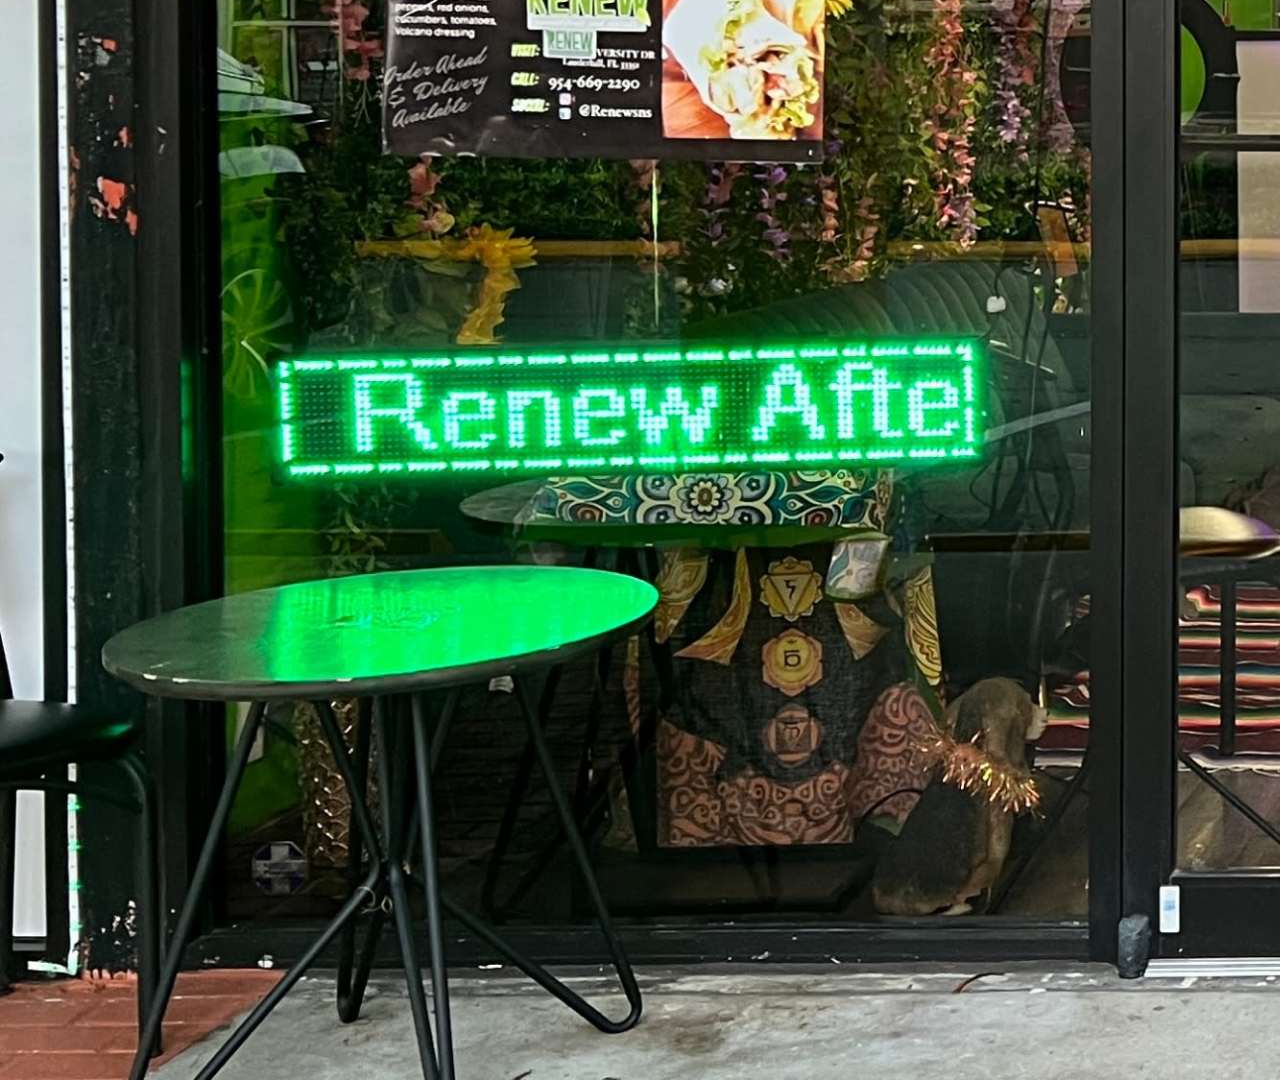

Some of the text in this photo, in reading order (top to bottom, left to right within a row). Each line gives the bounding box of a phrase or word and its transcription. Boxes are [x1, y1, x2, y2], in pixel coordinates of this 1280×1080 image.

[548, 31, 593, 49] RENEW
[436, 46, 488, 74] Ahead
[413, 76, 488, 101] Delivery
[548, 75, 640, 92] 954-669-2290
[392, 97, 472, 128] Available
[579, 104, 652, 118] @Renewsns
[352, 362, 959, 452] Renew Afte
